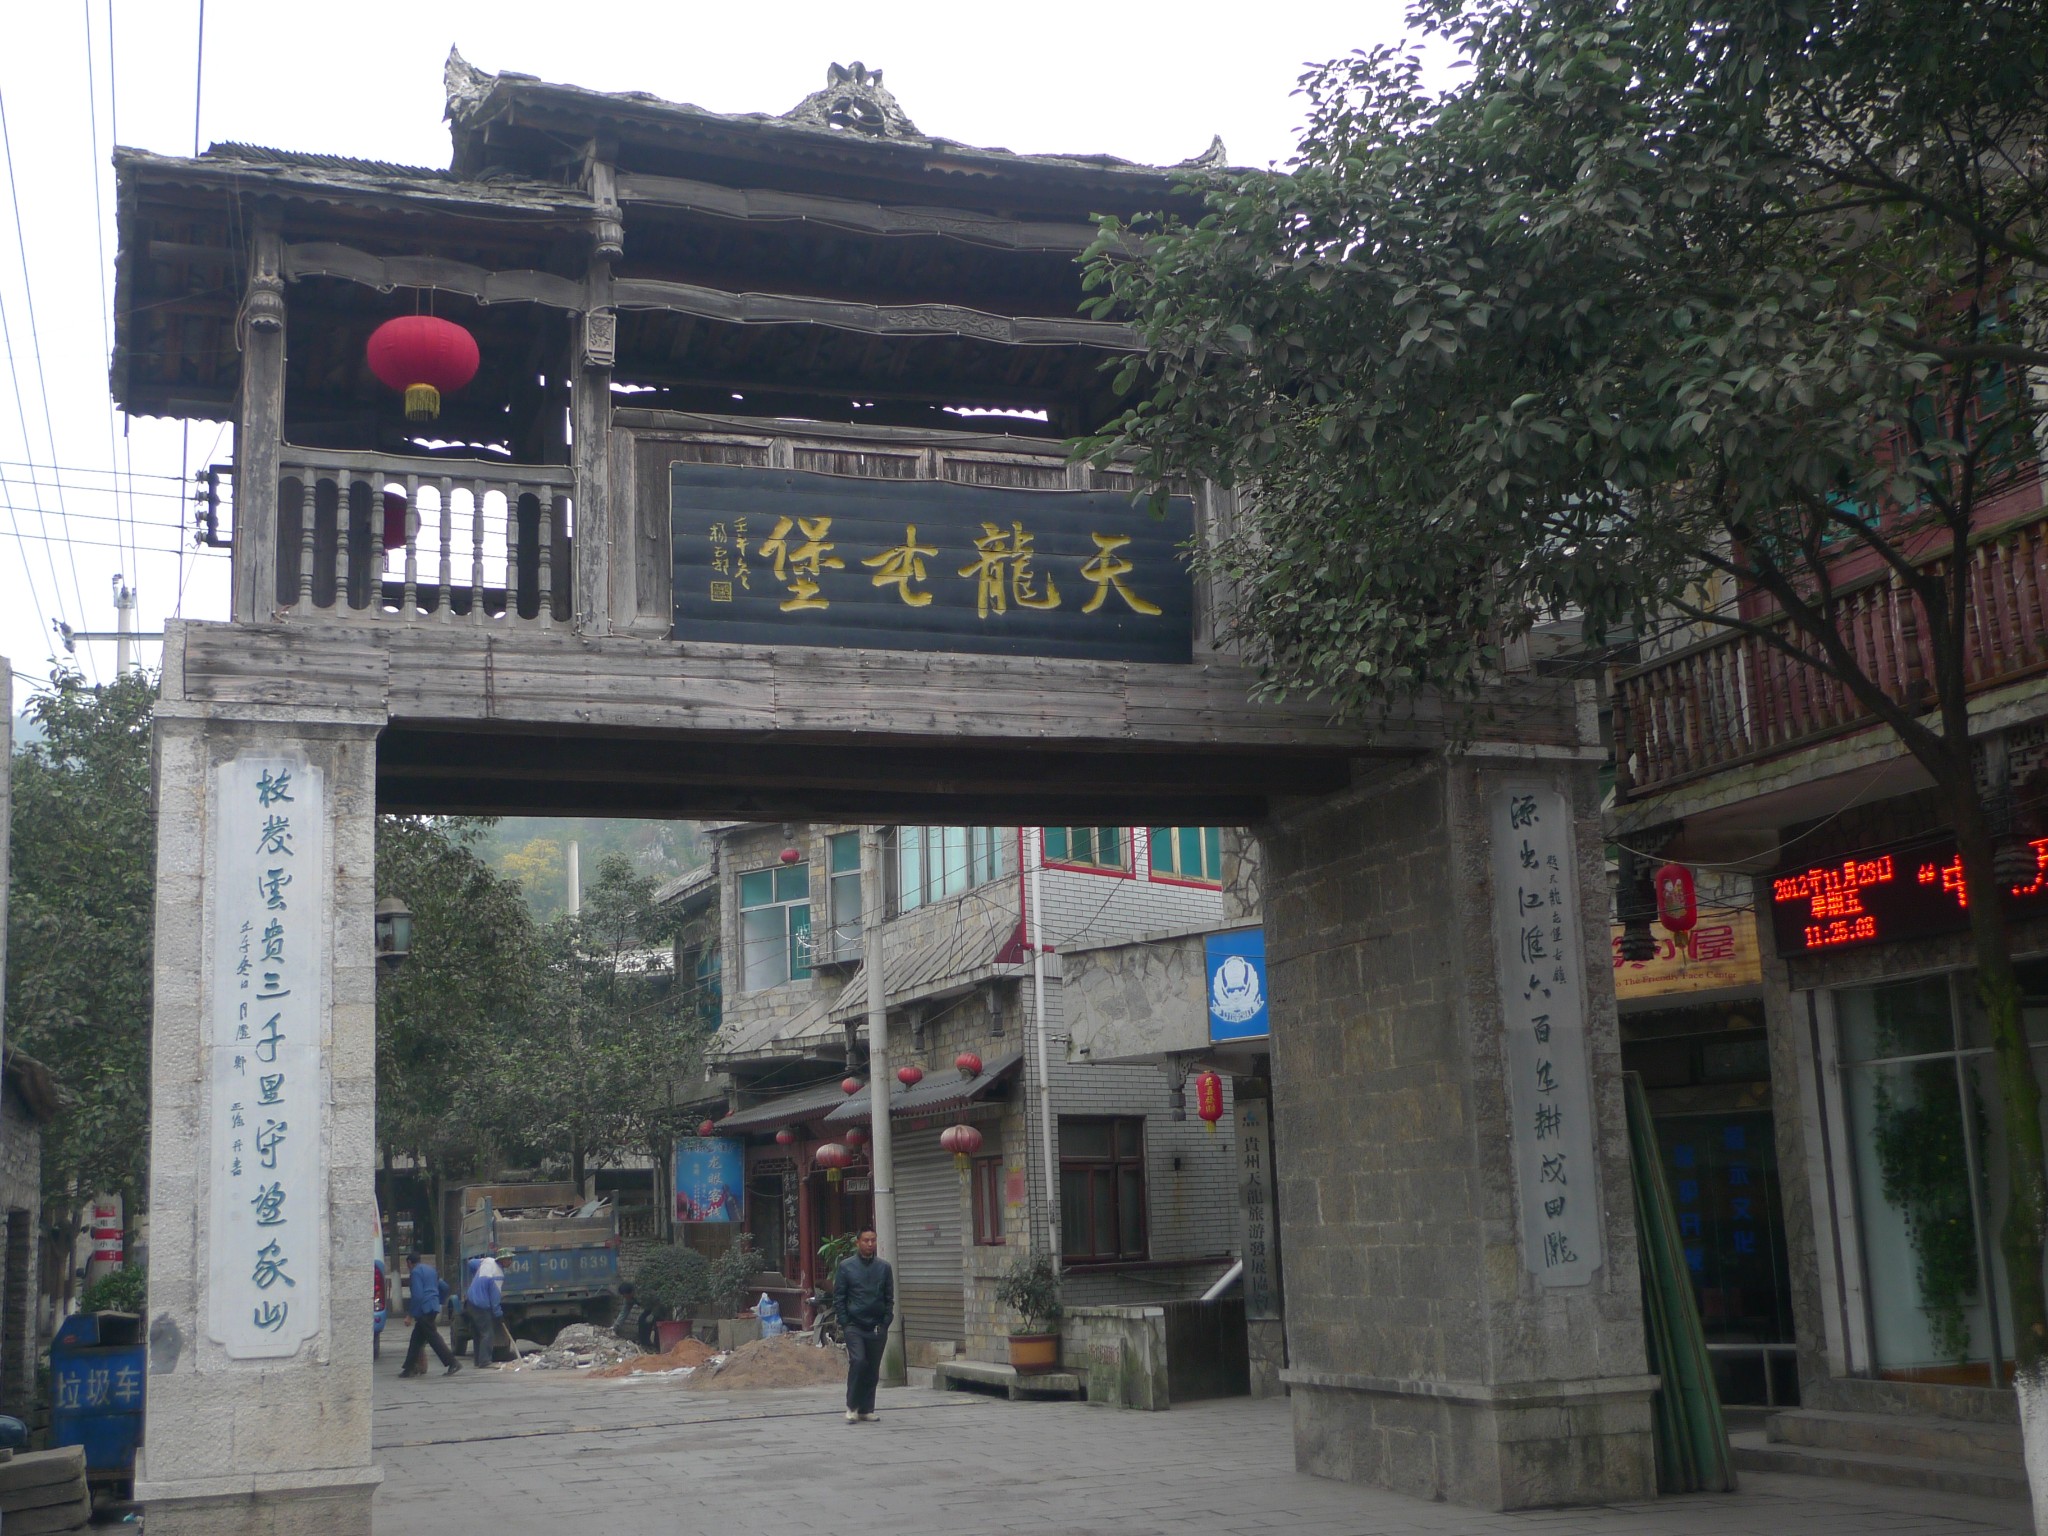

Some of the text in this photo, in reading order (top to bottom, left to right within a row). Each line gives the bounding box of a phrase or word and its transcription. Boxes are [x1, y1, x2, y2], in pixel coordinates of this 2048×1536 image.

[1773, 855, 1893, 902] 2012年11月23日
[1811, 888, 1864, 919] 星期五
[1682, 972, 1704, 980] Face
[1707, 970, 1737, 979] Center
[57, 1365, 140, 1409] 垃圾车
